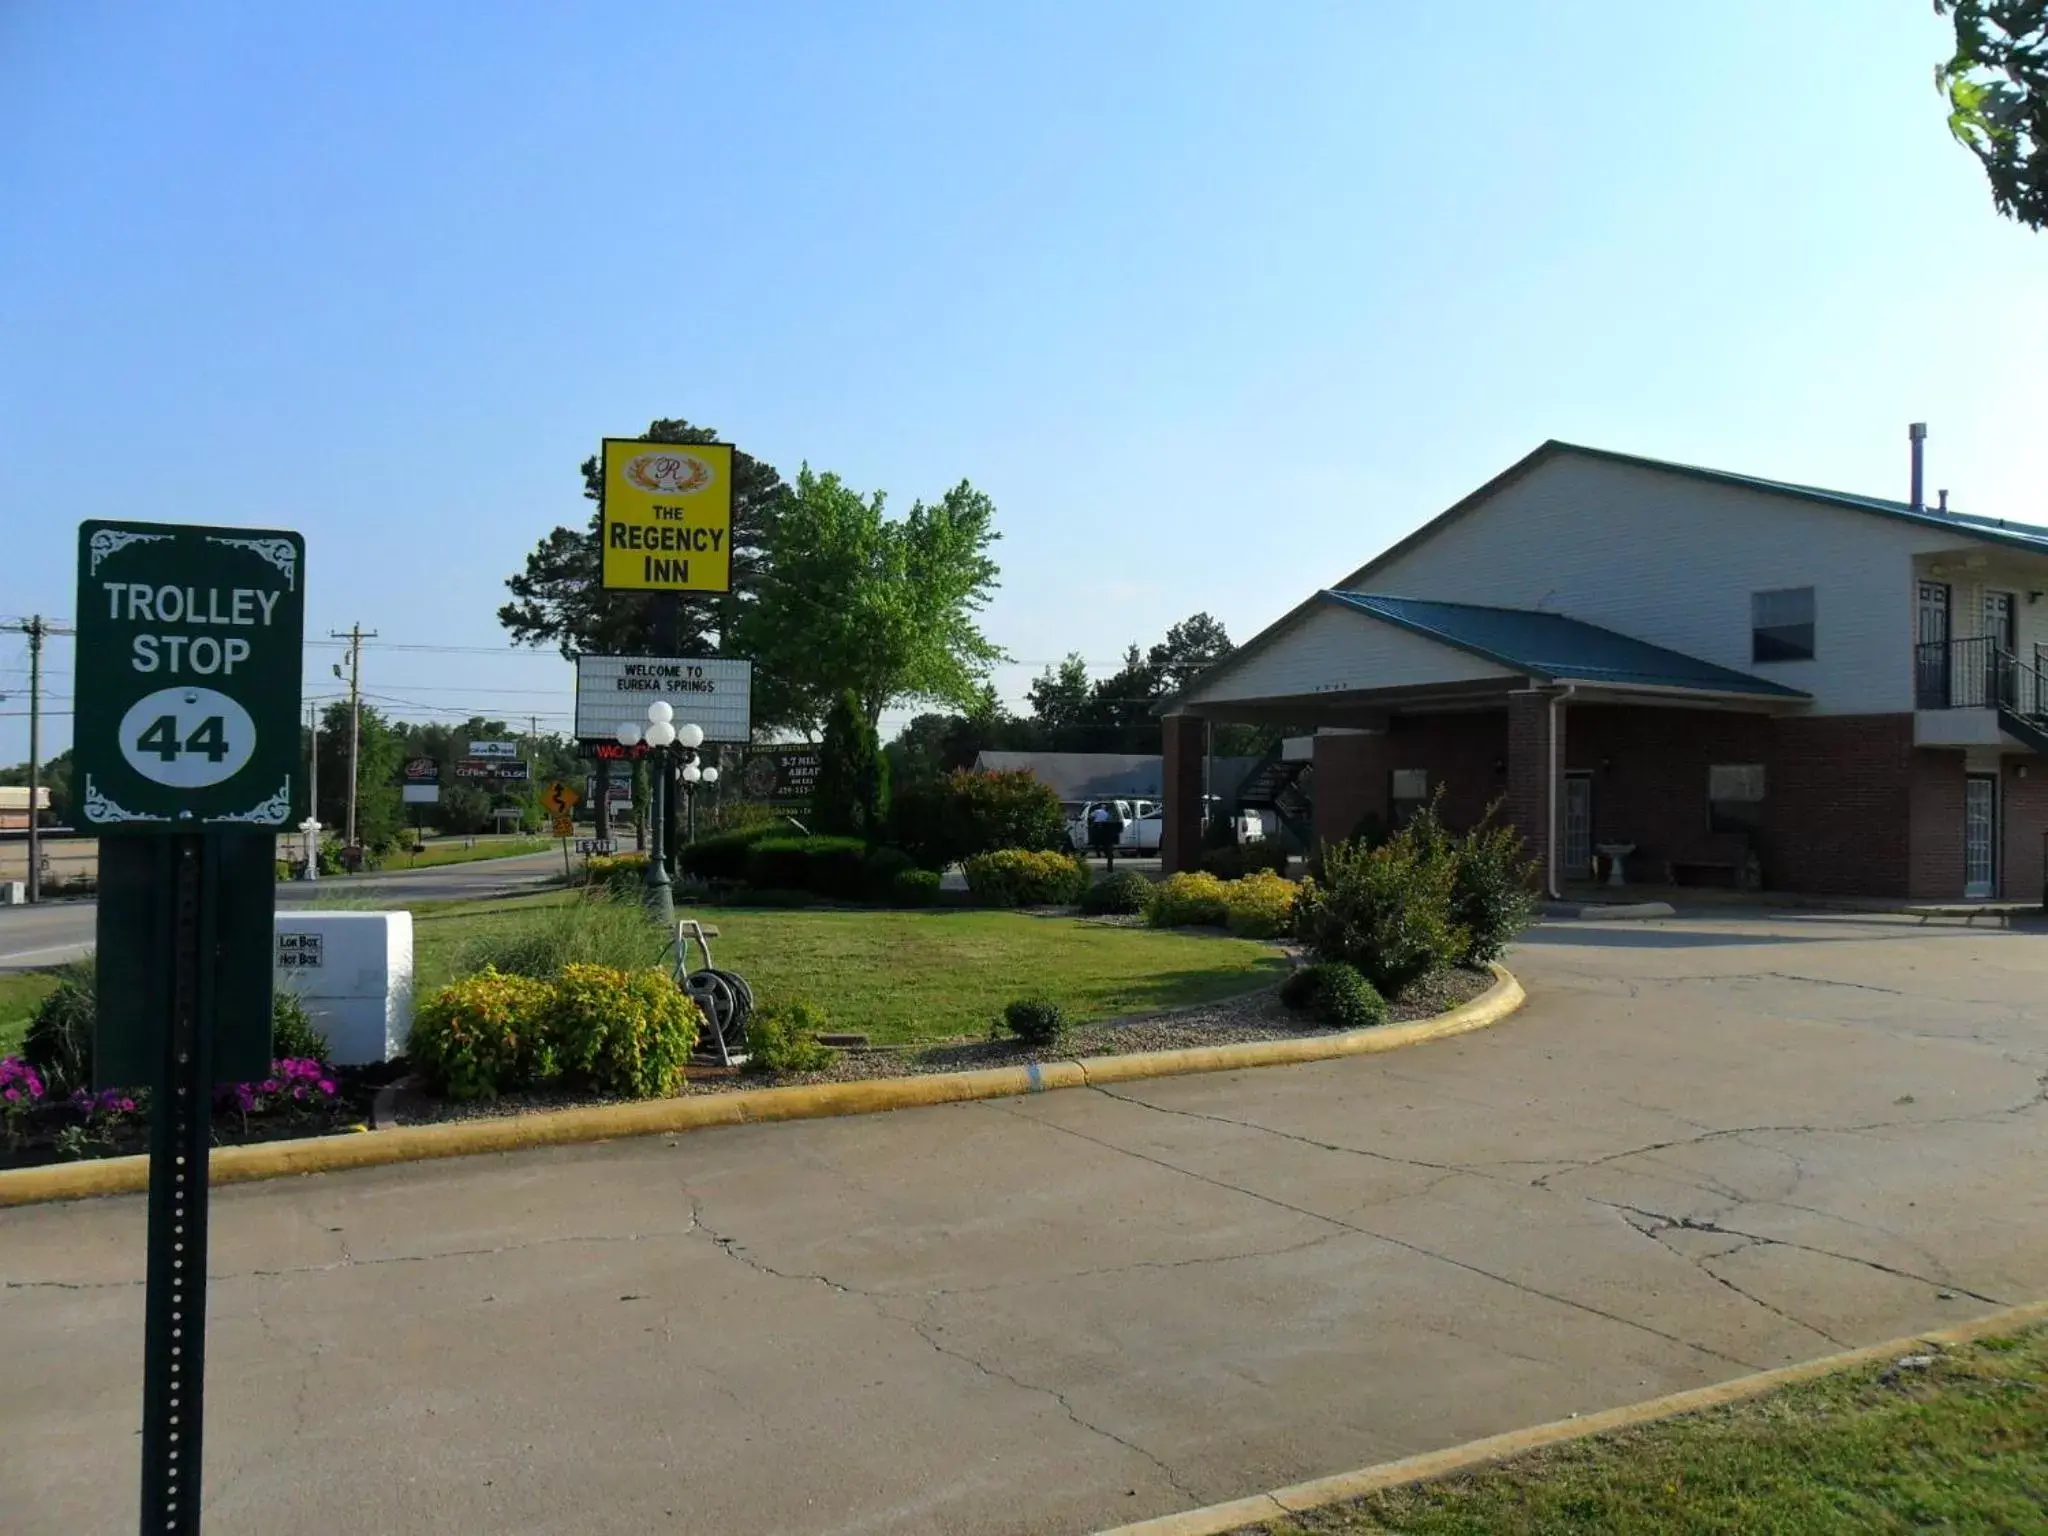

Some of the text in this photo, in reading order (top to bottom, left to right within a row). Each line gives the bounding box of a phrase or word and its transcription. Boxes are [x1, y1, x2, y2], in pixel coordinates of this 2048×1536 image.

[652, 505, 685, 521] THE
[610, 522, 724, 552] REGENCY
[644, 556, 689, 583] INN
[103, 582, 280, 626] TROLLEY
[132, 634, 250, 675] STOP
[624, 664, 703, 678] WELCOME TO
[617, 678, 715, 693] EUREKA SPRINGS
[136, 715, 230, 763] 44
